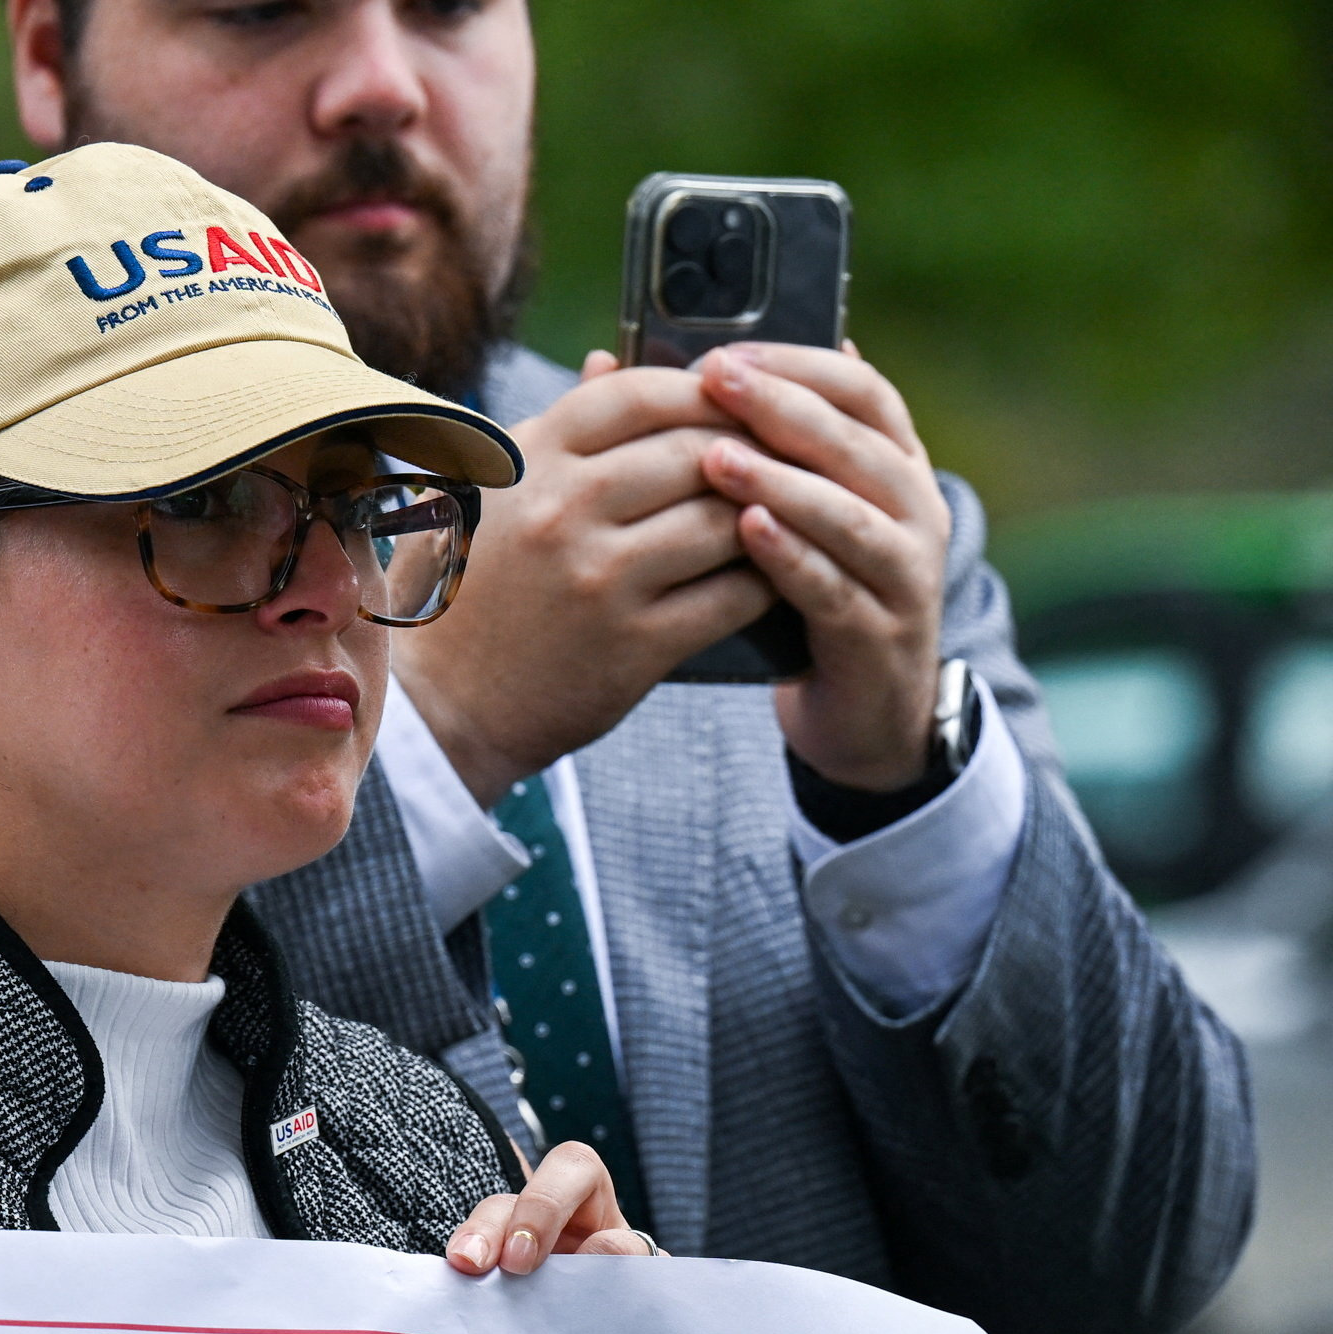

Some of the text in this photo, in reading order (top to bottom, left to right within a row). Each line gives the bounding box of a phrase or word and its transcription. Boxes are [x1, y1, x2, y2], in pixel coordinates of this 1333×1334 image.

[65, 226, 322, 301] USAID
[96, 295, 159, 334] FROM
[161, 283, 204, 306] THE
[208, 276, 301, 298] AMERICAN
[275, 1112, 315, 1142] USAID
